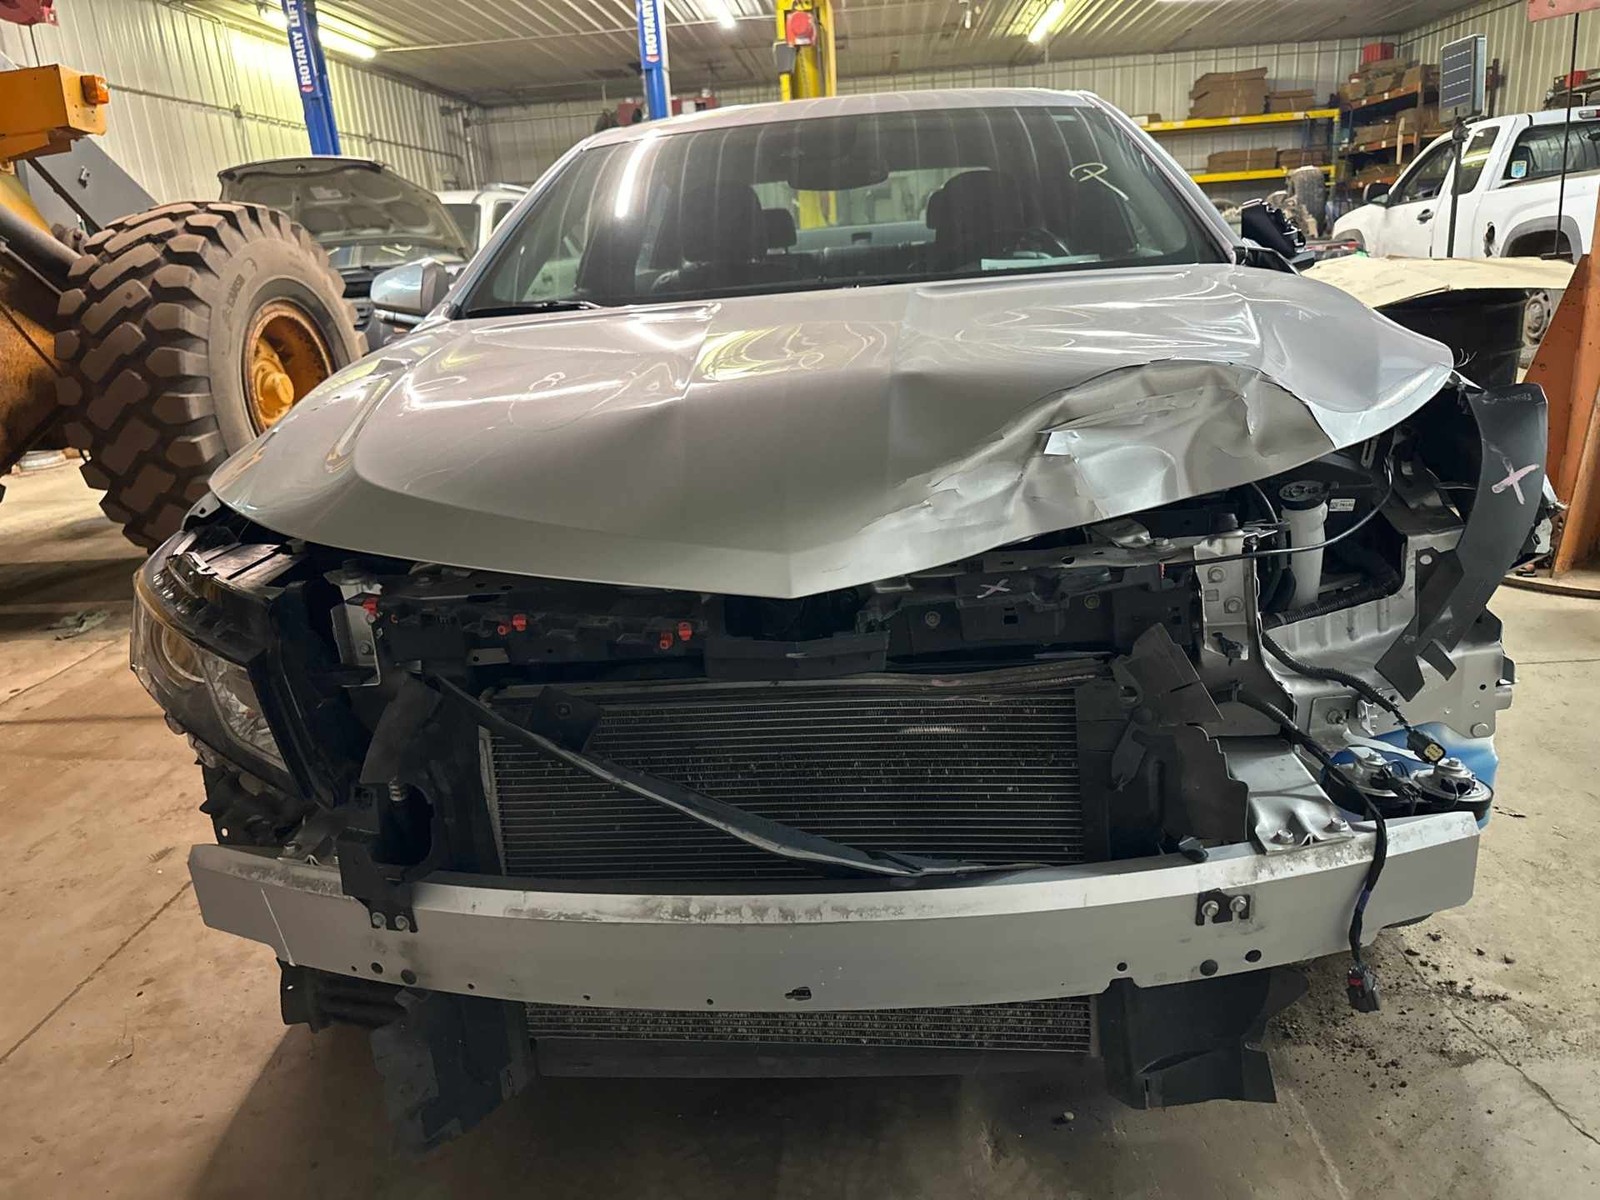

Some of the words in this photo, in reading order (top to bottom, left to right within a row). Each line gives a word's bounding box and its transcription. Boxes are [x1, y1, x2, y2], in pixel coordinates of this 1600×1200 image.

[286, 0, 301, 28] LIFT
[641, 0, 658, 55] ROTARY
[291, 31, 312, 86] ROTARY
